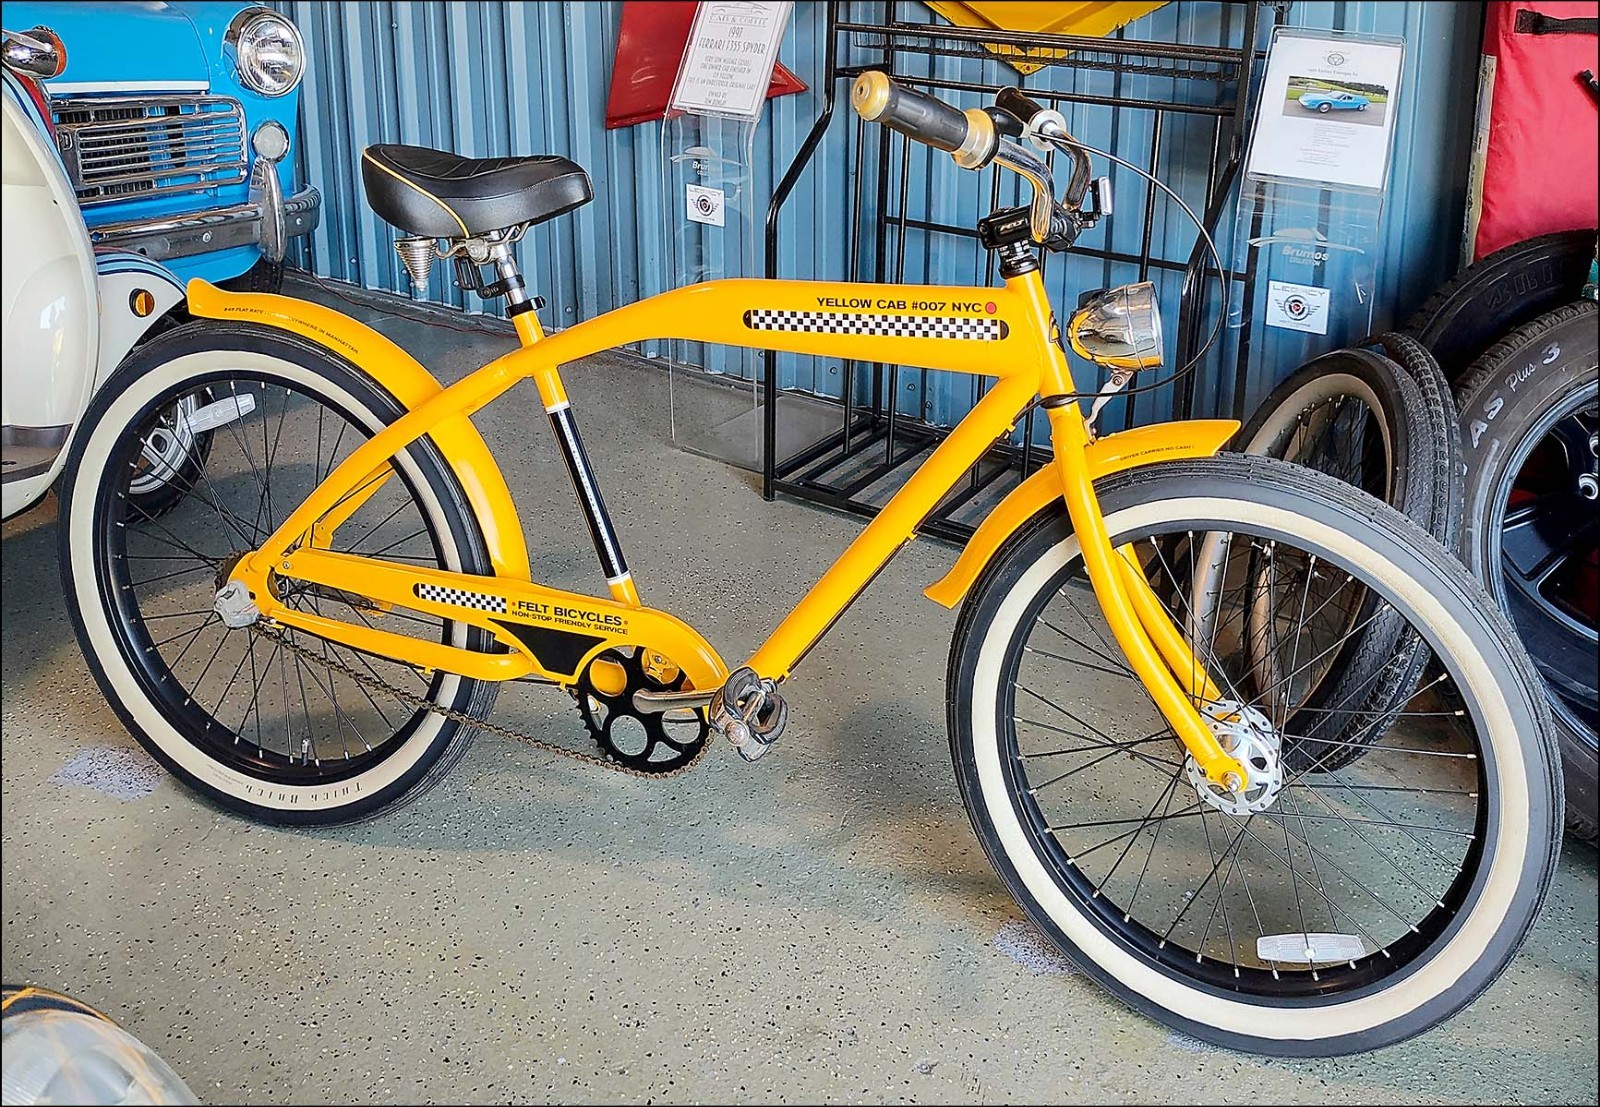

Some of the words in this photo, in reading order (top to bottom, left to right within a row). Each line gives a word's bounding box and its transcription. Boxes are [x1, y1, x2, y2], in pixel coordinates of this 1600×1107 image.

[728, 26, 744, 38] 1997
[698, 37, 726, 50] FERRARI
[726, 39, 741, 52] F355
[742, 41, 766, 54] SPYDER
[816, 297, 872, 309] YELLOW
[876, 299, 907, 310] CAB
[911, 301, 947, 311] #007
[951, 302, 982, 313] NYC
[1504, 362, 1537, 394] Plus
[1540, 341, 1562, 367] 3
[511, 609, 553, 622] NON-STOP
[554, 617, 592, 629] FRIENDLY
[593, 623, 629, 636] SERVICE
[518, 600, 549, 614] FELT
[553, 606, 622, 626] BICYCLES
